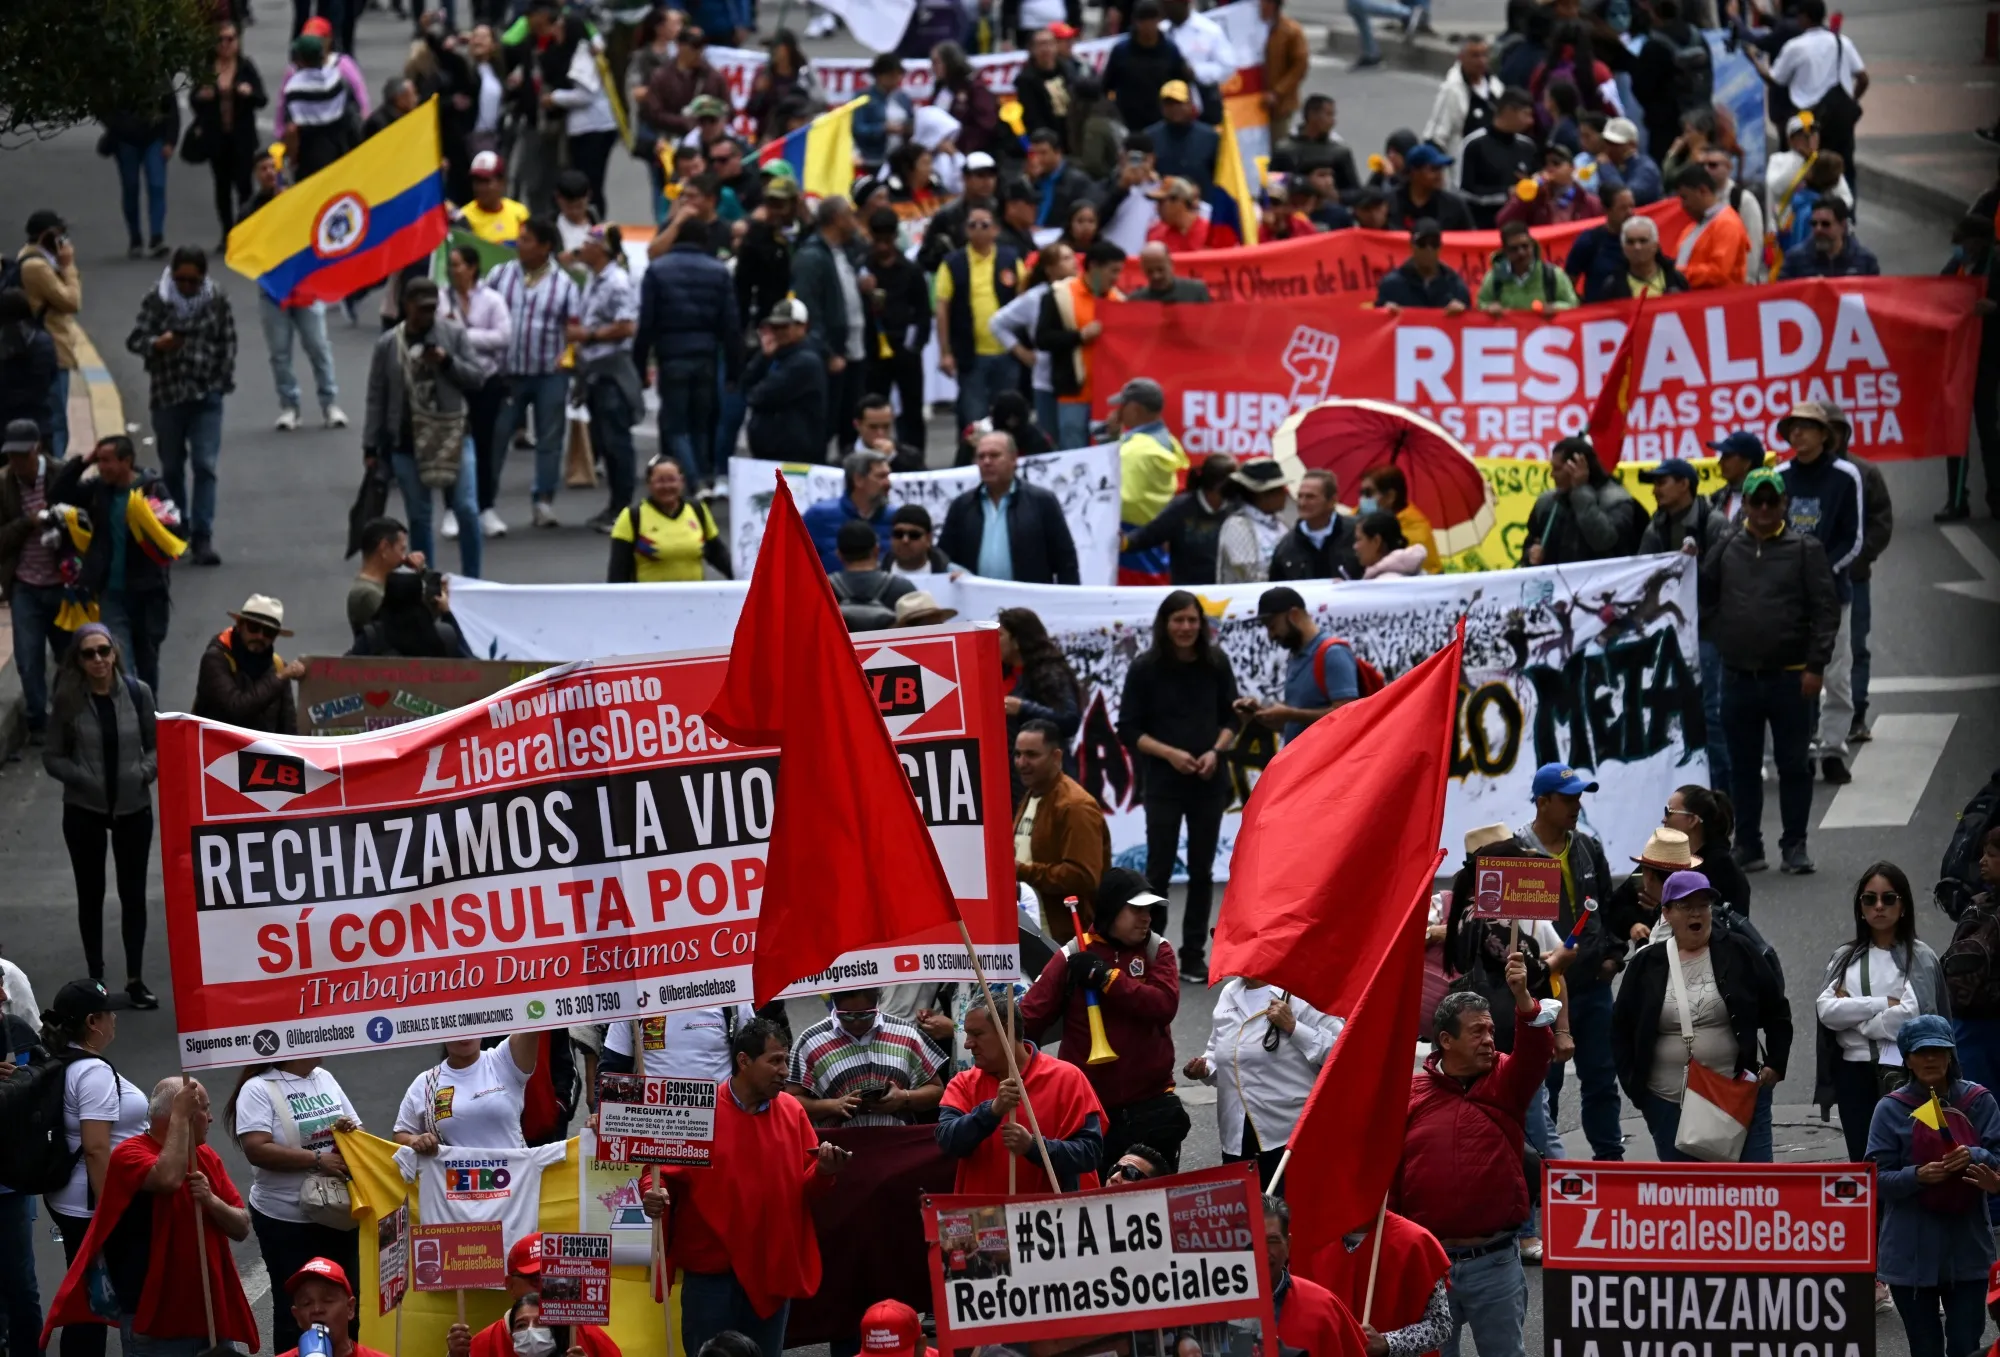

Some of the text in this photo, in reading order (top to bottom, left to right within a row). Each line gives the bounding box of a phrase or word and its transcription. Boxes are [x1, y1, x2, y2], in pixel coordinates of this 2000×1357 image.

[1395, 292, 1890, 404] RESPALDA
[1478, 389, 1700, 441] REFOMAS
[1711, 372, 1902, 423] SOCIALES
[487, 674, 663, 729] Movimiento
[1523, 624, 1707, 778] META
[416, 703, 730, 794] LiberalesDeBas
[247, 758, 300, 787] LB
[199, 790, 579, 906] RECHAZAMOS
[597, 780, 668, 858] LA
[1490, 860, 1527, 868] CONSULTA
[1528, 861, 1561, 869] POPULAR
[1503, 882, 1560, 903] LiberalesDeBase
[257, 857, 767, 974] SÍ CONSULTA POP
[923, 955, 936, 970] 90
[299, 958, 484, 1015] ¡Trabajando
[494, 953, 571, 986] Duro
[580, 937, 700, 976] Estamos
[659, 979, 736, 1005] @liberalesdebase
[555, 991, 621, 1017] 316 309 7590
[396, 1008, 514, 1035] LIBERALES DE BASE COMUNICACIONES
[235, 1033, 251, 1046] en:
[286, 1025, 355, 1048] @liberalesbase
[646, 1079, 715, 1105] SÍ CONSULTA
[666, 1093, 715, 1108] POPULAR
[290, 1093, 334, 1114] NUEVO
[625, 1106, 674, 1117] PREGUNTA
[645, 1122, 661, 1130] SENA
[601, 1135, 622, 1144] VOTA
[631, 1142, 709, 1158] LiberalesDeBase
[609, 1140, 626, 1161] SÍ
[444, 1159, 508, 1169] PRESIDENTE
[445, 1168, 512, 1191] PETRO
[447, 1192, 471, 1200] CAMBIO
[1637, 1182, 1779, 1207] Movimiento
[1173, 1201, 1247, 1222] REFORMA
[424, 1227, 465, 1235] CONSULTA
[466, 1224, 502, 1233] POPULAR
[1015, 1203, 1163, 1263] #Sí A Las
[1188, 1218, 1229, 1230] A LA
[1573, 1207, 1845, 1252] LiberalesDeBase
[544, 1235, 562, 1256] SÍ
[562, 1236, 608, 1248] CONSULTA
[1175, 1228, 1252, 1249] SALUD
[443, 1250, 504, 1271] LiberalesDeBase
[562, 1246, 608, 1258] POPULAR
[545, 1264, 606, 1276] LiberalesDeBase
[584, 1278, 607, 1286] VOTA
[954, 1257, 1249, 1323] ReformasSociales
[586, 1285, 603, 1302] SÍ
[1571, 1275, 1847, 1331] RECHAZAMOS
[576, 1309, 604, 1317] COLOMBIA
